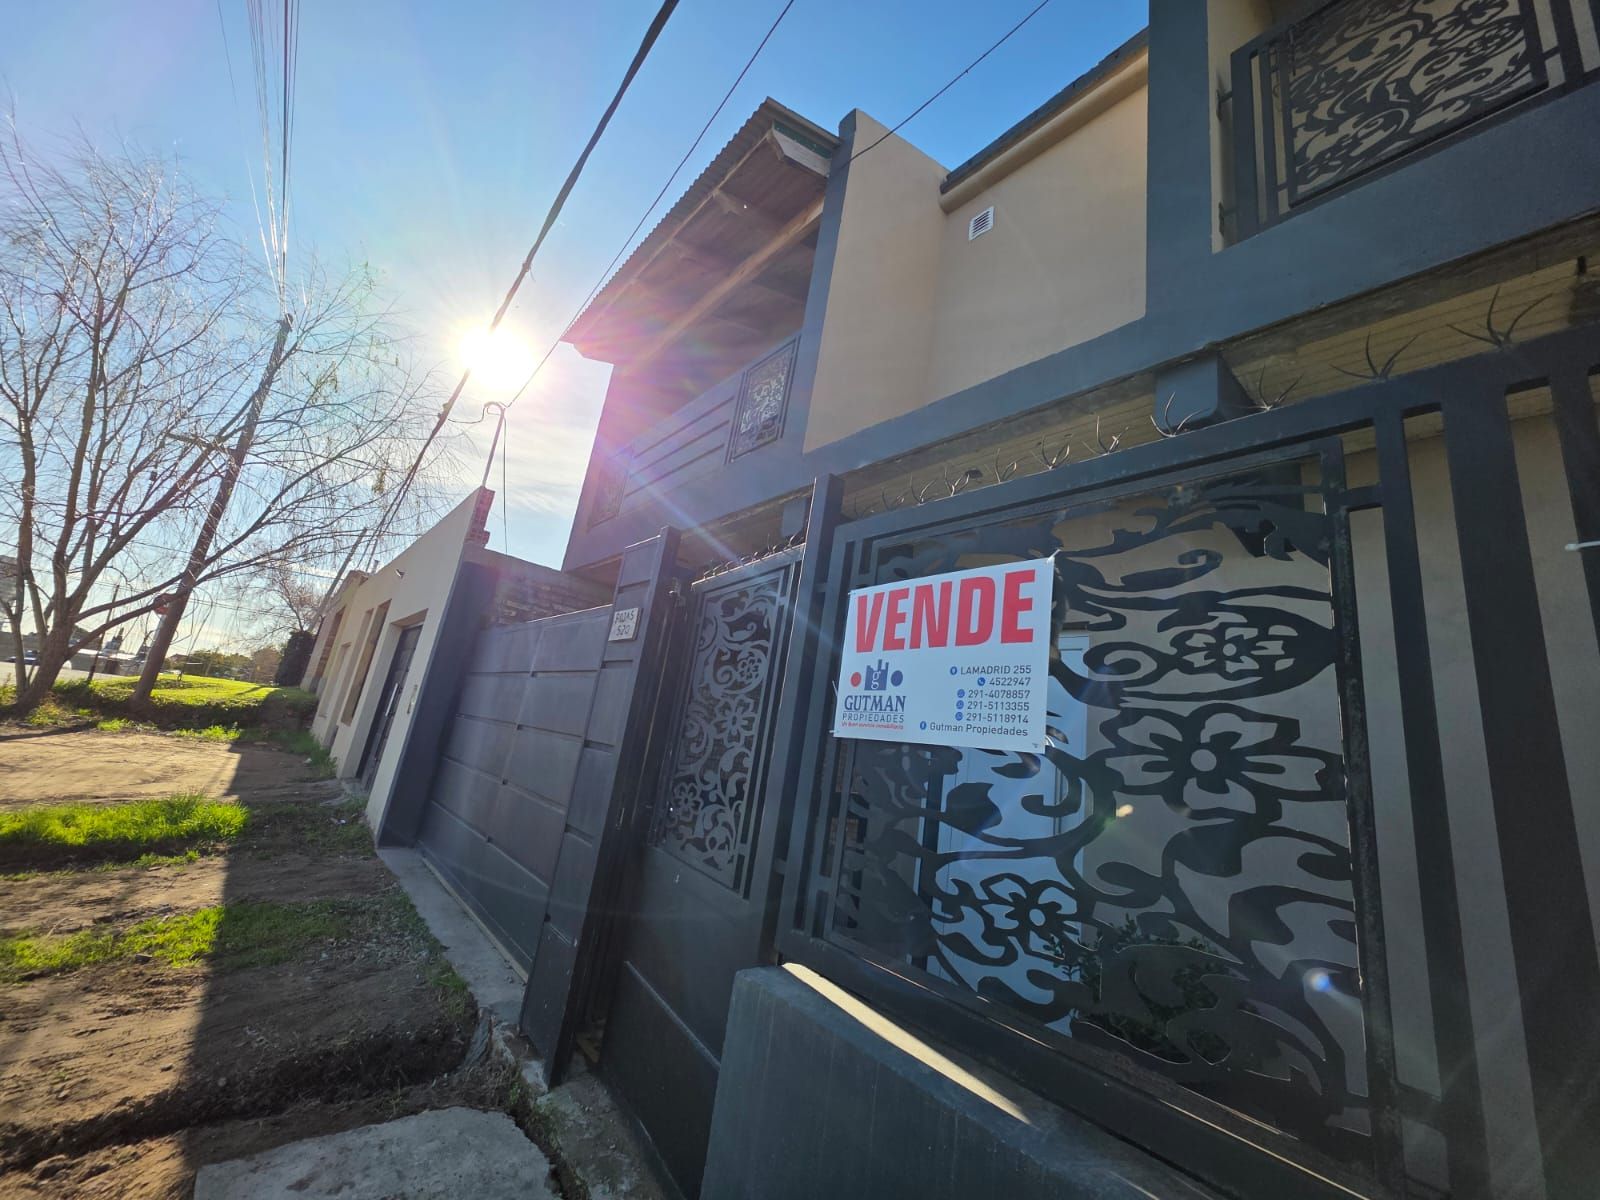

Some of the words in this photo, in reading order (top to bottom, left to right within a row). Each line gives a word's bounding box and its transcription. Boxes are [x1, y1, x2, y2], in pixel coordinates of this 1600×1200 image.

[856, 569, 1036, 653] VENDE
[960, 665, 1011, 675] LAMADRID
[1013, 664, 1032, 674] 255
[989, 677, 1032, 687] 4522947
[968, 689, 1031, 699] 291-4078857
[844, 694, 907, 712] GUTMAN
[967, 701, 1030, 711] 291-5113355
[842, 712, 905, 723] PROPIEDADES
[965, 712, 1029, 724] 291-5118914
[929, 722, 964, 732] Gutman
[965, 723, 1029, 737] Propiedades
